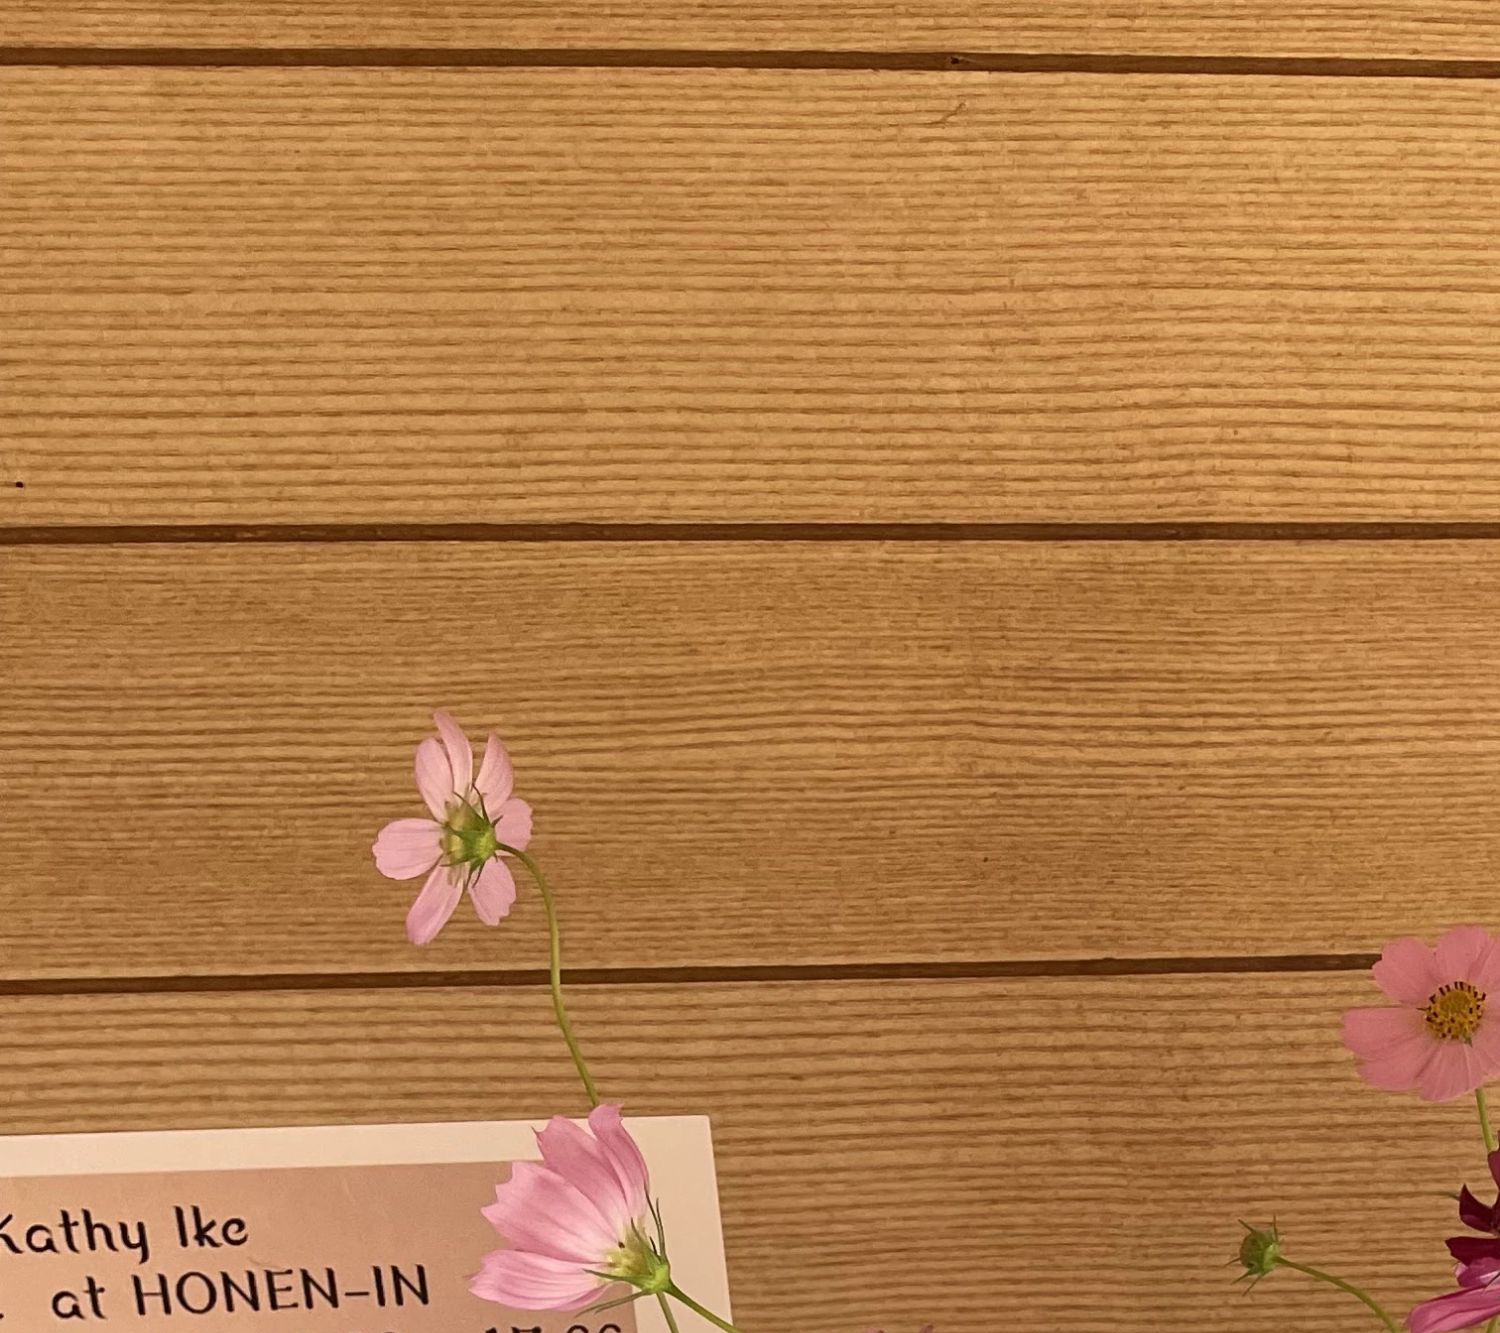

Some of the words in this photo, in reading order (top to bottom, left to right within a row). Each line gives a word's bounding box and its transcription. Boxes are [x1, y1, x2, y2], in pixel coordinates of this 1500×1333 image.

[0, 1207, 150, 1265] Kathy
[173, 1204, 249, 1249] Ike
[51, 1275, 108, 1320] at
[130, 1264, 430, 1317] HONEN-IN
